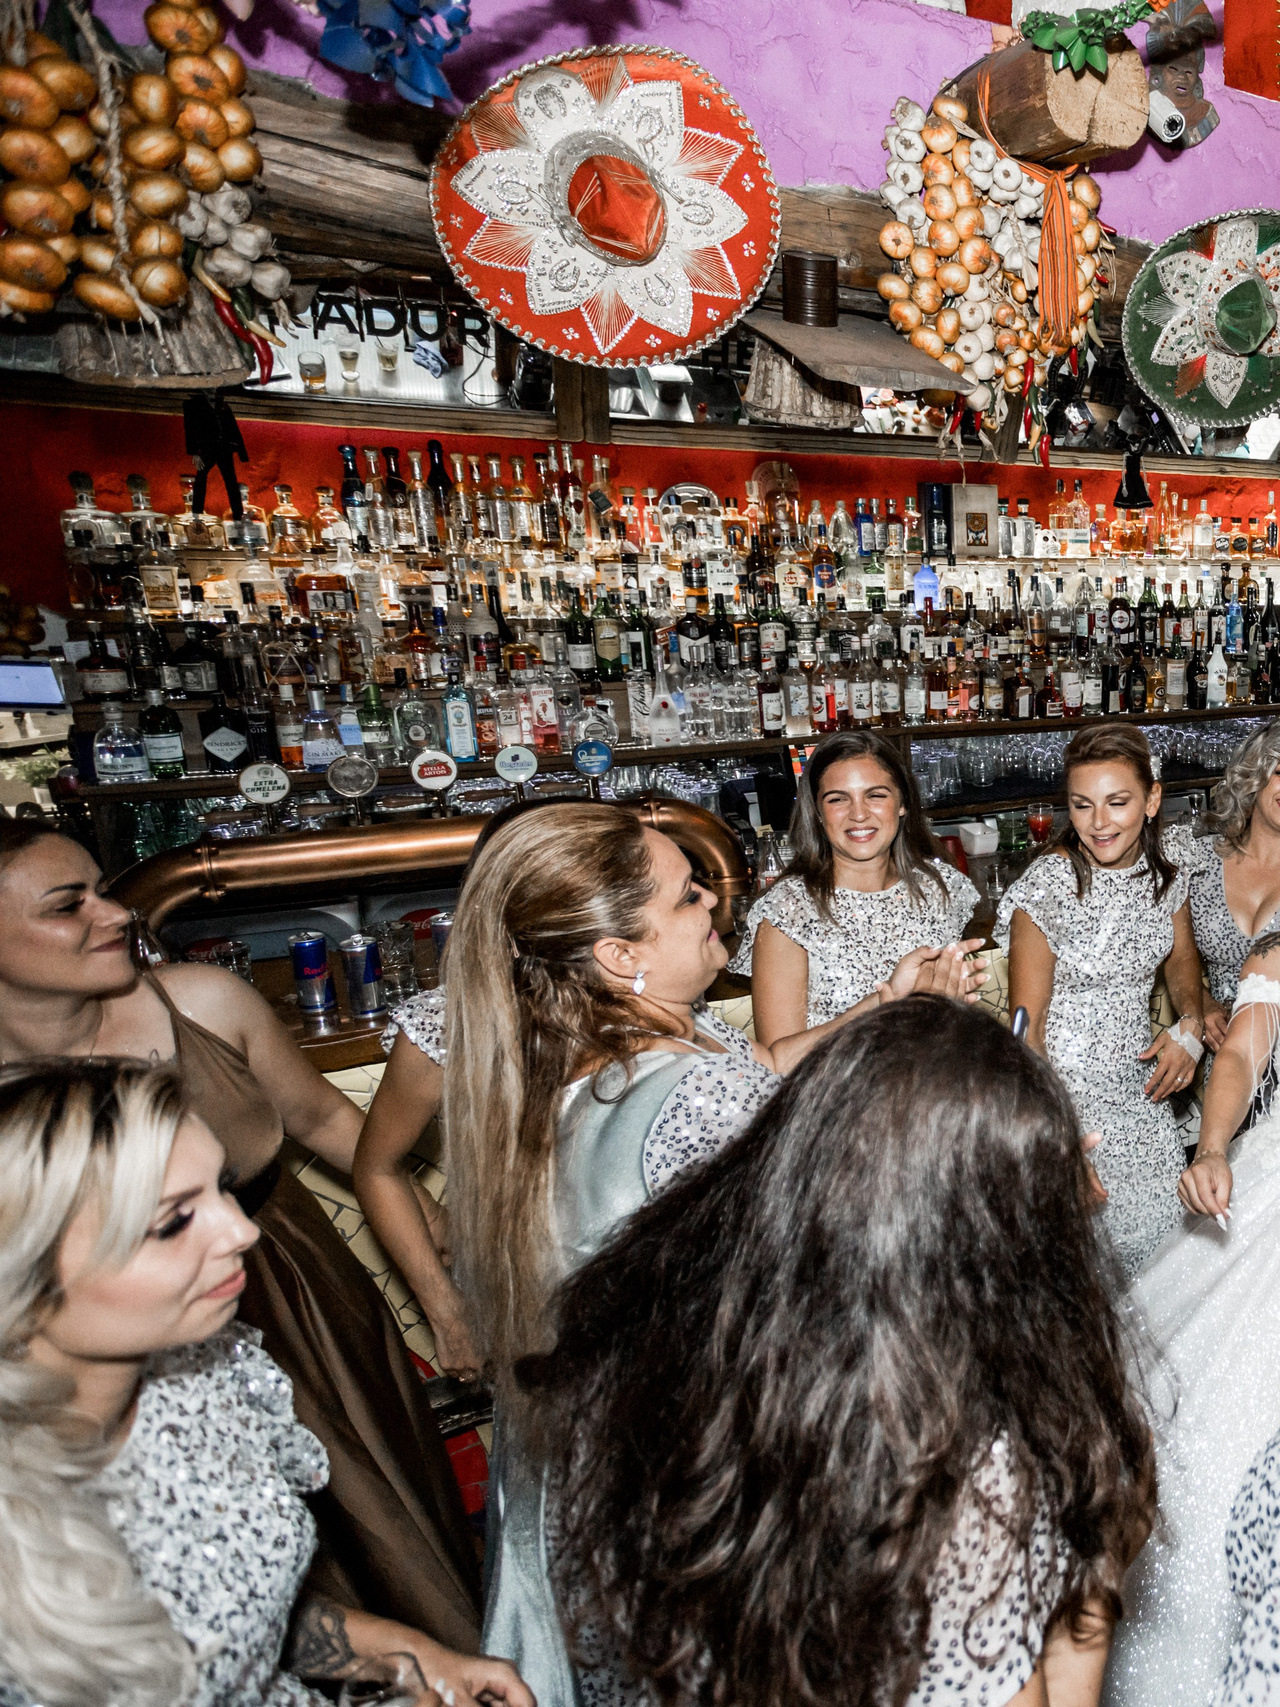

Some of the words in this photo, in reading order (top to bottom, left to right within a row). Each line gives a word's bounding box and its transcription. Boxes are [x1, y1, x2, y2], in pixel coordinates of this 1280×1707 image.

[502, 714, 514, 722] 24
[250, 726, 268, 735] GIN
[422, 764, 446, 772] STELLA
[423, 769, 447, 777] ARTOIS
[253, 779, 278, 787] EXTRA
[245, 783, 286, 793] CHMELENÁ
